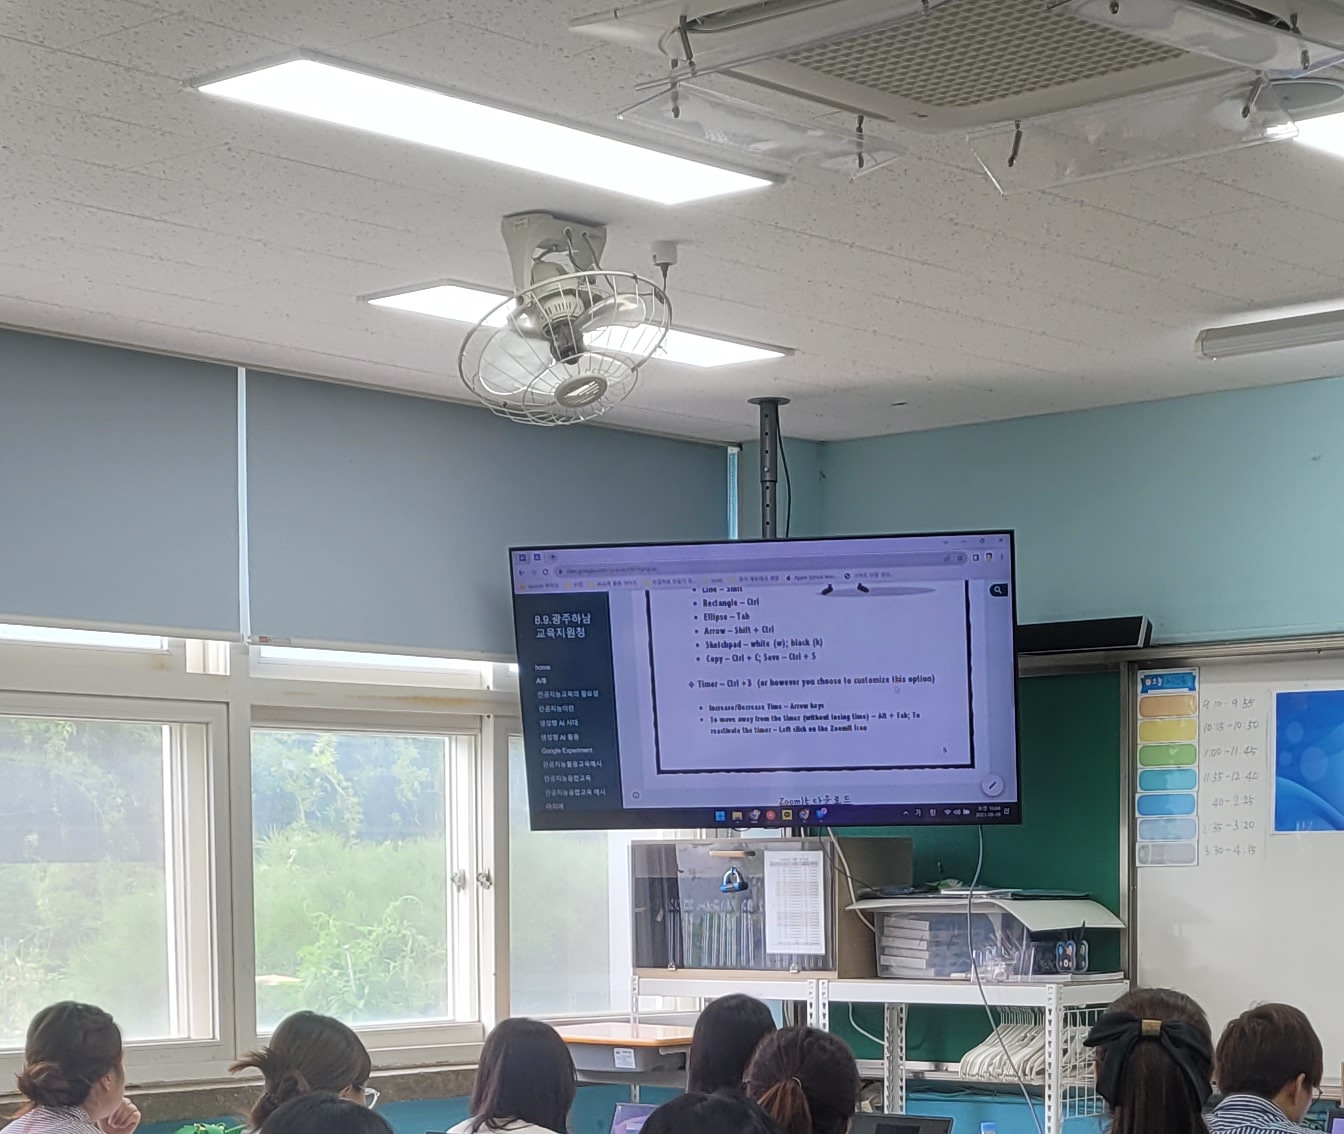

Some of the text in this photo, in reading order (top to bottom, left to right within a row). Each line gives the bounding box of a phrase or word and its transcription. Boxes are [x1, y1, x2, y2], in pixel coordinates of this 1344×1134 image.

[703, 598, 759, 608] Rectangle Ctrl
[535, 613, 591, 624] 8.9.광주하남
[704, 612, 750, 622] Ellipse Tab
[536, 627, 585, 638] 교육지원청
[704, 625, 774, 635] Arrow Shift Ctrl
[750, 639, 770, 648] white
[791, 638, 810, 647] black
[706, 655, 723, 664] Copy
[732, 654, 744, 662] Ctrl
[763, 653, 779, 662] Save
[789, 652, 801, 661] Ctrl
[698, 680, 718, 688] Timer
[770, 678, 799, 687] however
[801, 679, 815, 687] you
[817, 677, 841, 685] choose
[844, 676, 851, 684] to
[854, 676, 889, 684] customize
